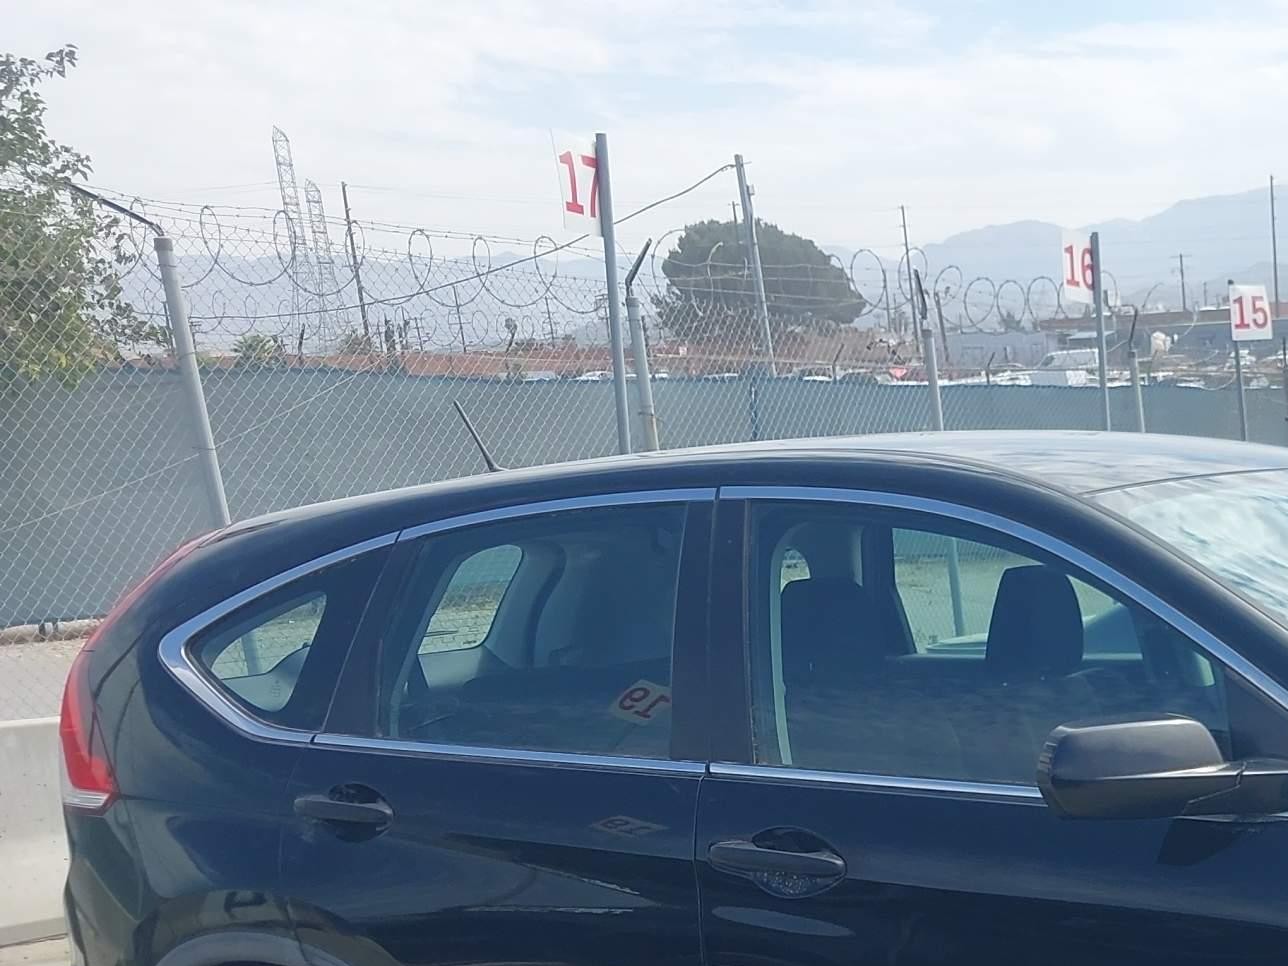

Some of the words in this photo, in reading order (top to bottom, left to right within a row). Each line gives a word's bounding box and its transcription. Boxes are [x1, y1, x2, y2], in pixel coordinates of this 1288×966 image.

[558, 150, 599, 218] 17
[1063, 244, 1095, 291] 16
[1232, 295, 1269, 330] 15
